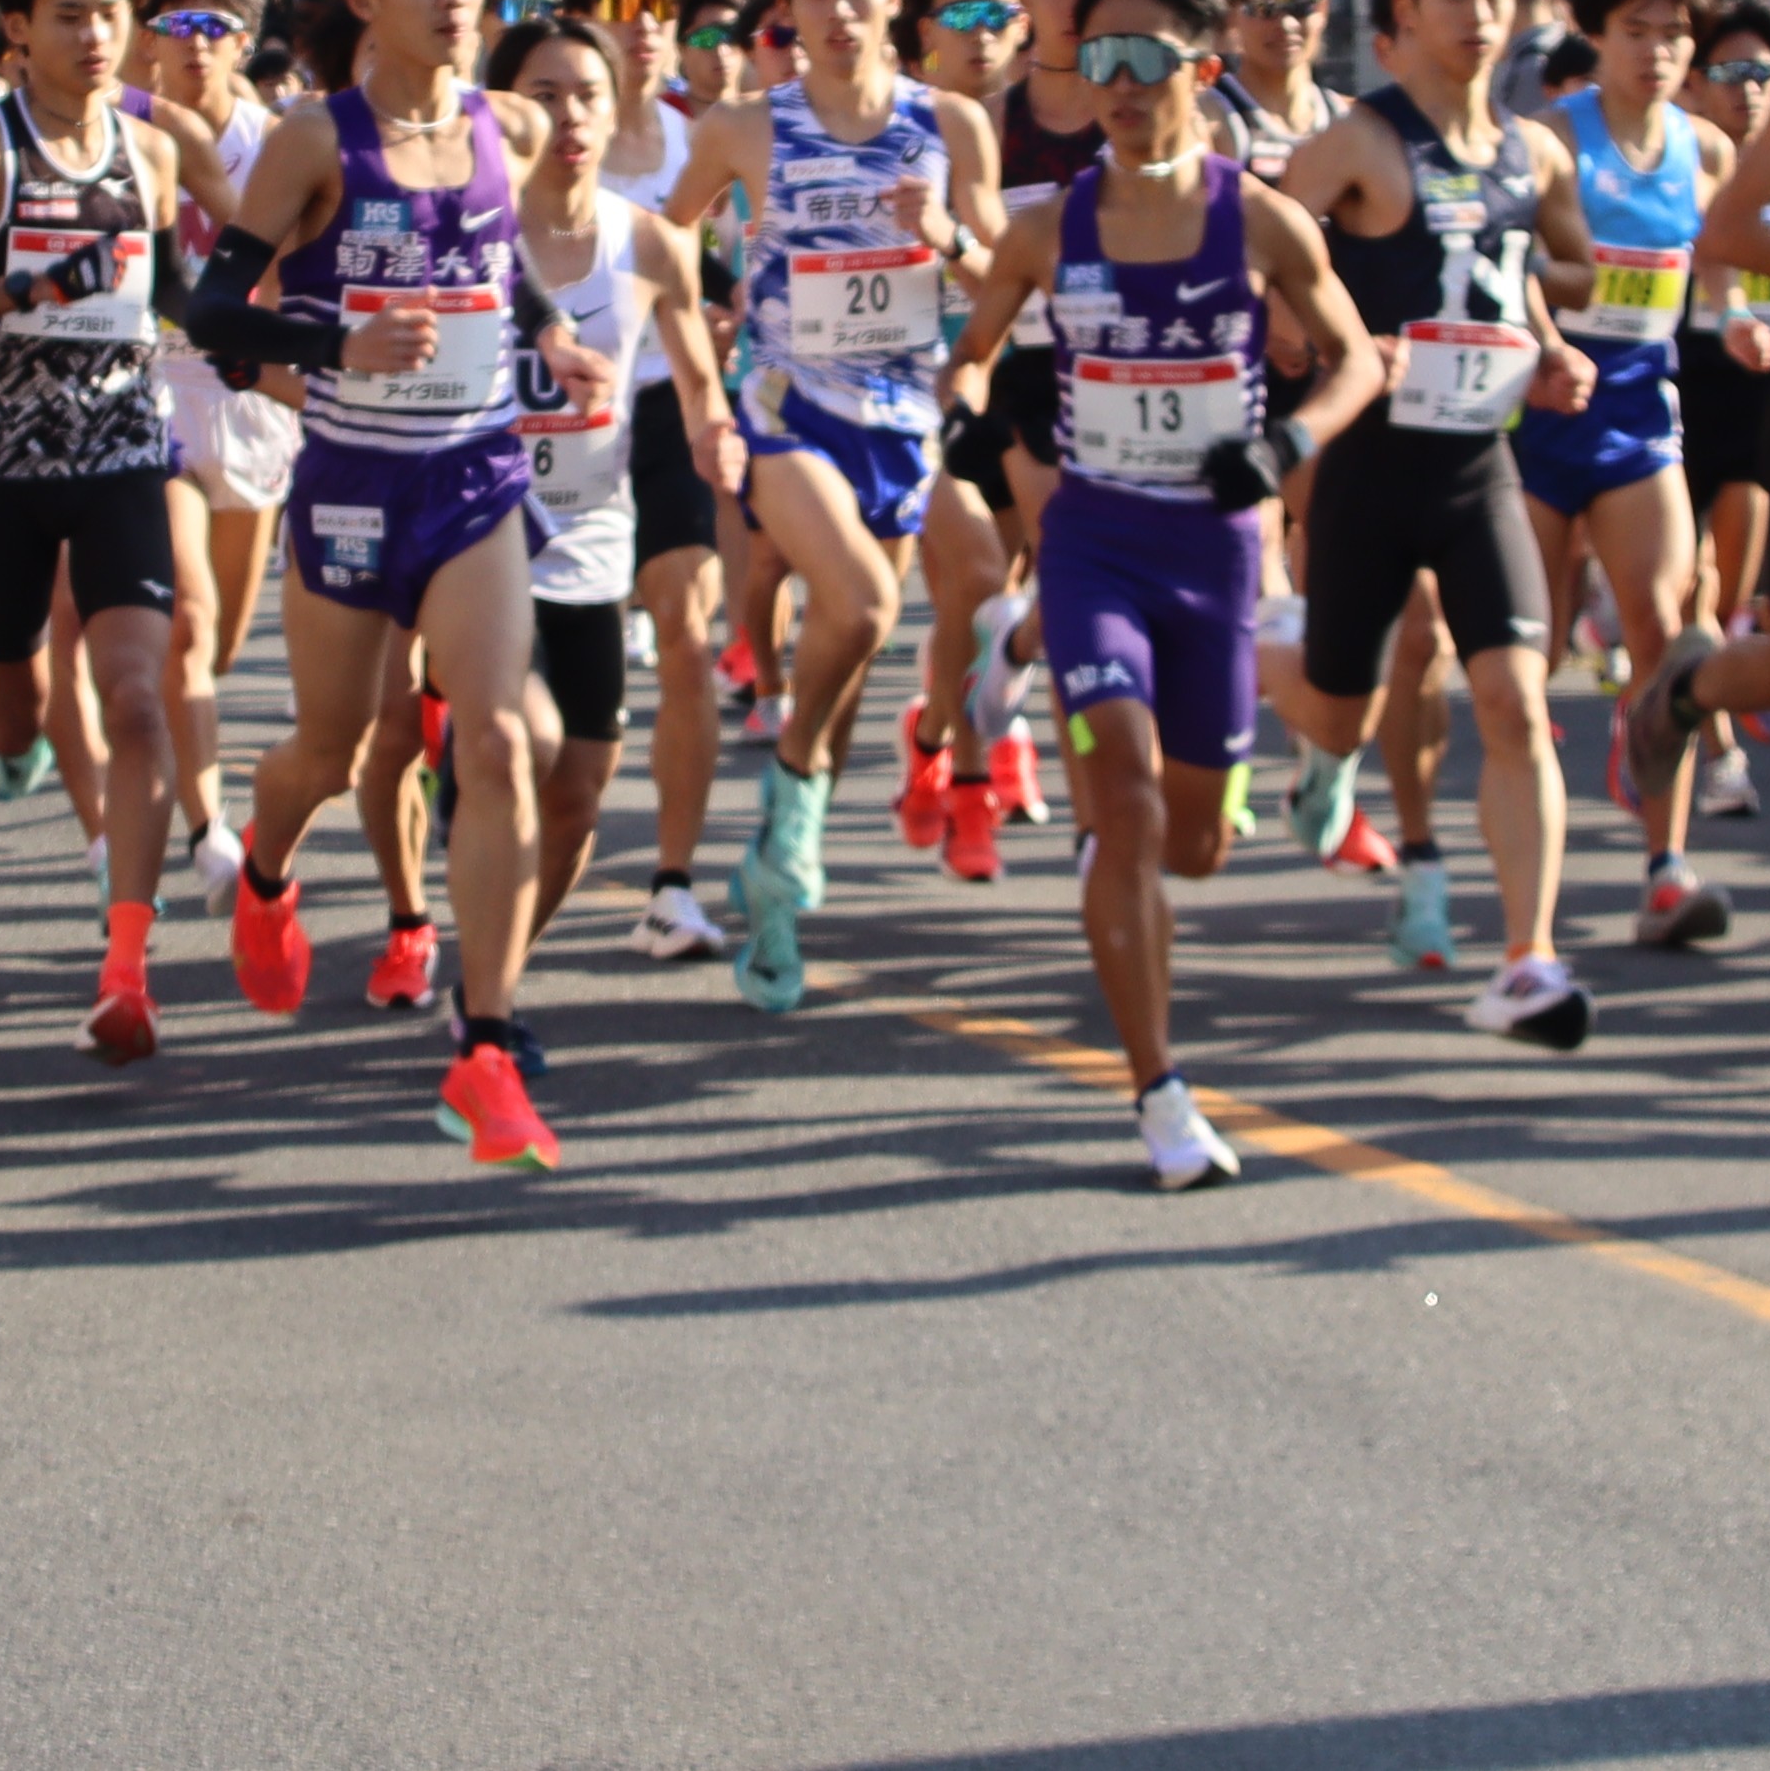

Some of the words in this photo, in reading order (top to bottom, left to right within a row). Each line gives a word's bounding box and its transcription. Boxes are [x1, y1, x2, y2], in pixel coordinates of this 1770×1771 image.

[845, 272, 891, 315] 20
[44, 314, 115, 332] アイダ設計
[383, 381, 468, 400] アイダ設計
[1455, 349, 1491, 392] 12
[1134, 390, 1183, 432] 13
[533, 438, 553, 476] 6
